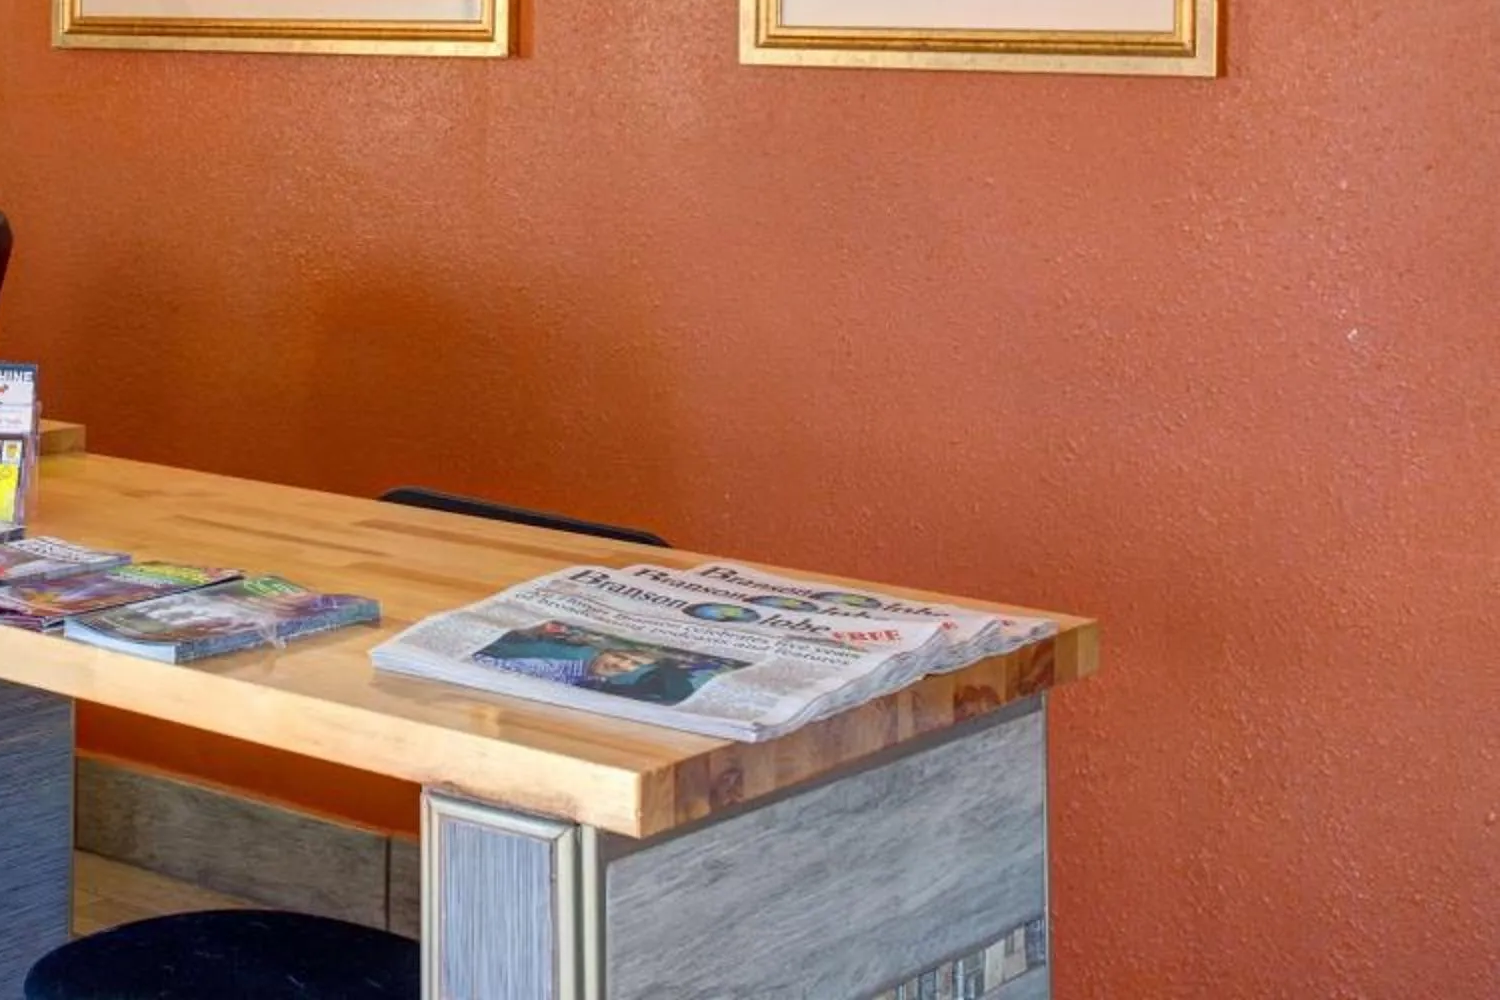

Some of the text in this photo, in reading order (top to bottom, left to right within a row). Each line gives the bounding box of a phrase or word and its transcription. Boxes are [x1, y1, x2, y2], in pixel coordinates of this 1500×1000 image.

[569, 569, 689, 608] Branson
[633, 568, 749, 602] Branson
[700, 566, 812, 597] Branson
[832, 630, 900, 642] FREE
